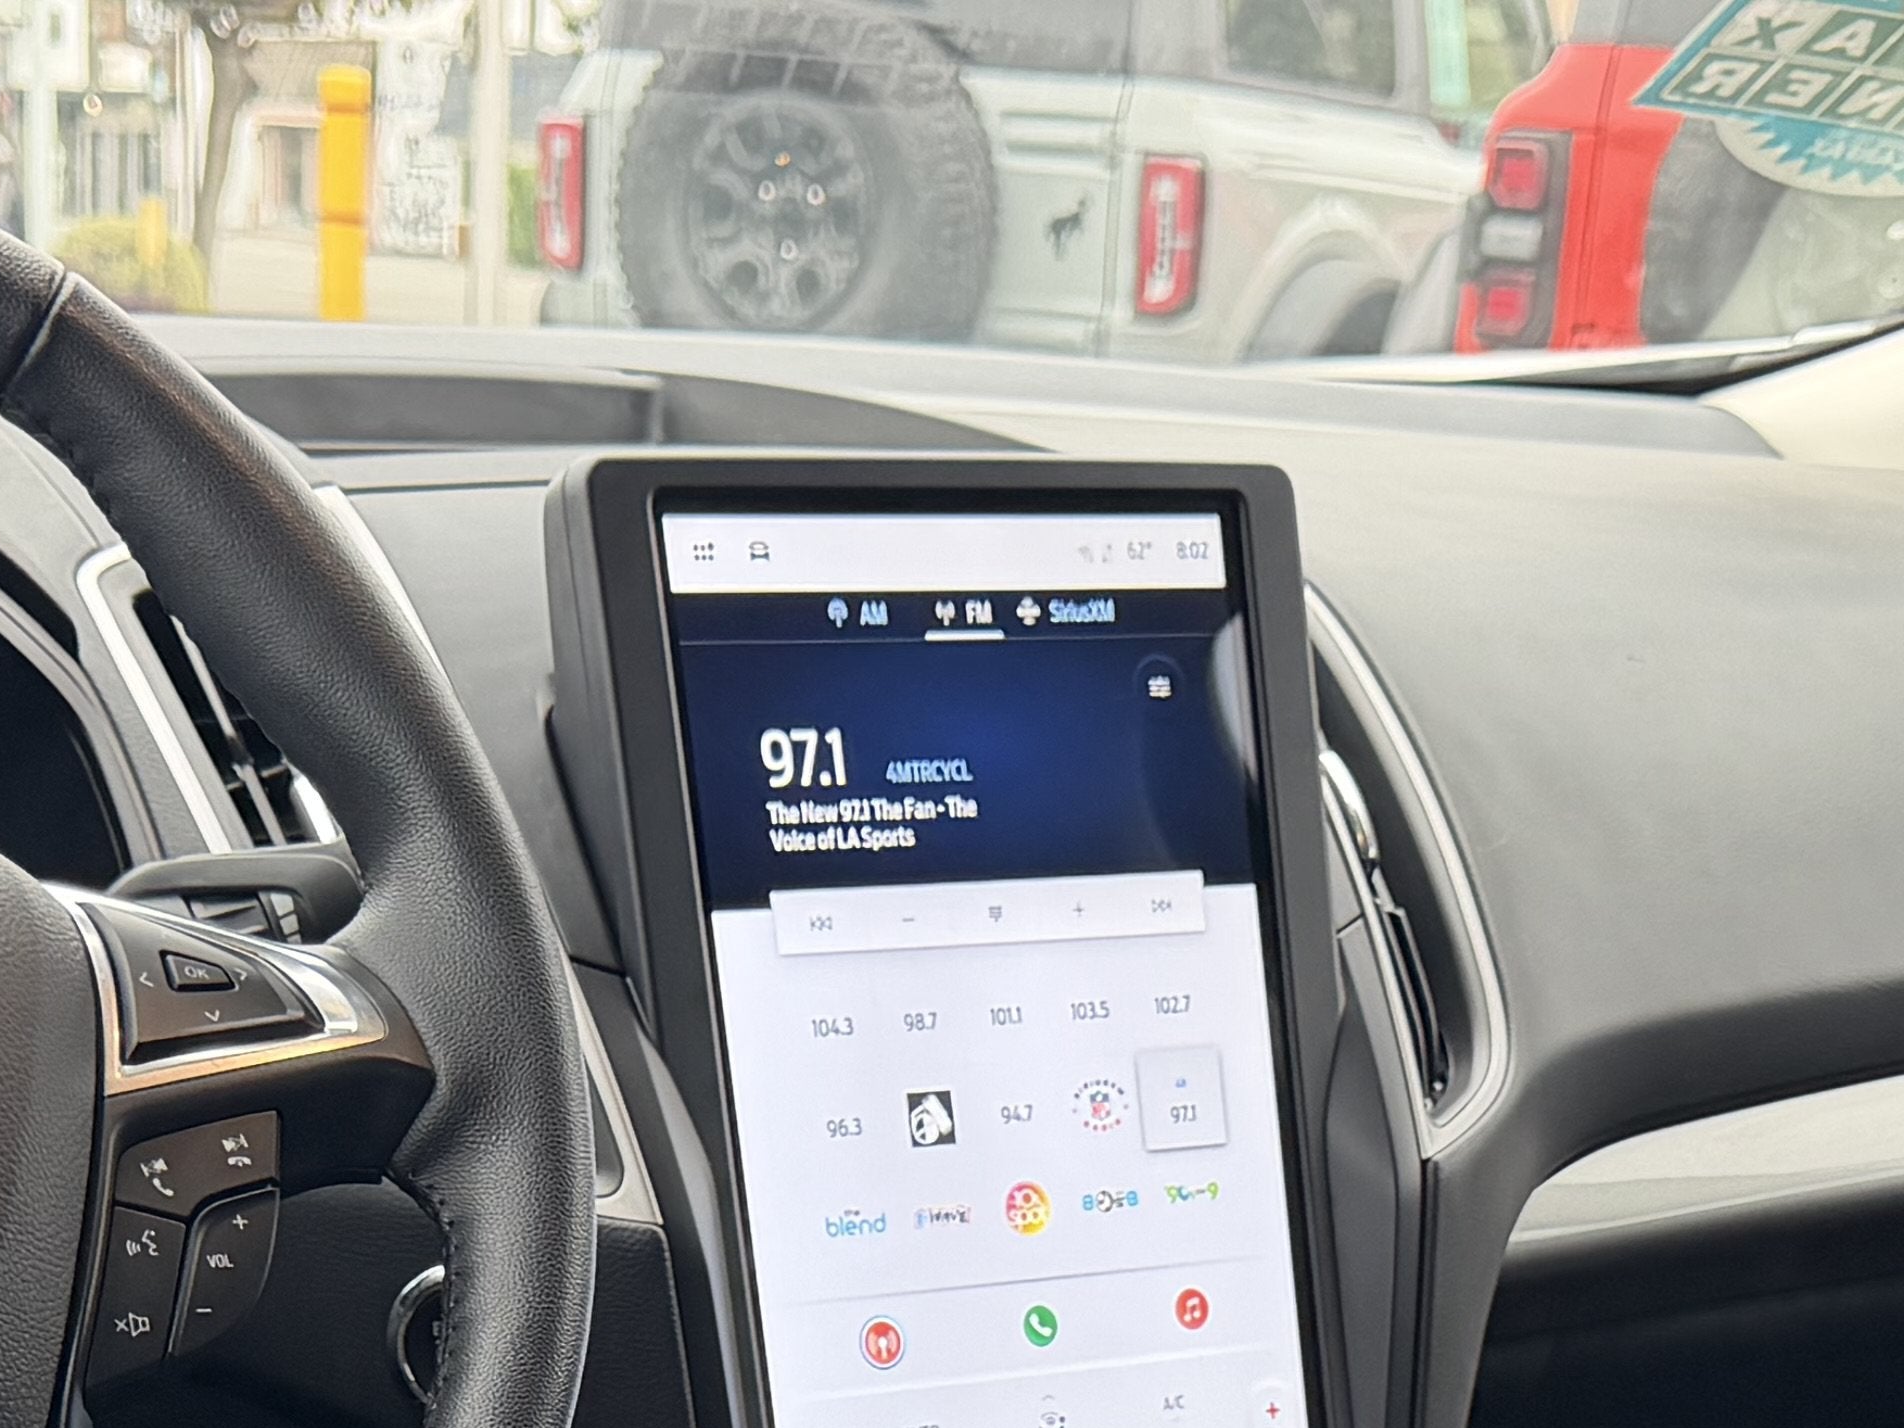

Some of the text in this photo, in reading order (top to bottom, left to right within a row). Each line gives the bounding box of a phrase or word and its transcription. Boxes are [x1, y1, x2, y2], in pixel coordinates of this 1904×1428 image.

[859, 600, 889, 626] AM
[964, 599, 994, 625] FM
[760, 727, 847, 788] 97.1
[765, 794, 978, 825] The New 97.1 The Fan The
[769, 825, 916, 852] Voice of LA Sports
[184, 965, 210, 980] OK
[811, 1017, 855, 1039] 104.3
[902, 1012, 938, 1032] 98.7
[1070, 1000, 1111, 1021] 103.5
[1154, 995, 1192, 1016] 102.7
[826, 1104, 1197, 1138] 96.3 94.7 97.1
[825, 1212, 886, 1238] blend
[206, 1253, 234, 1268] VOL
